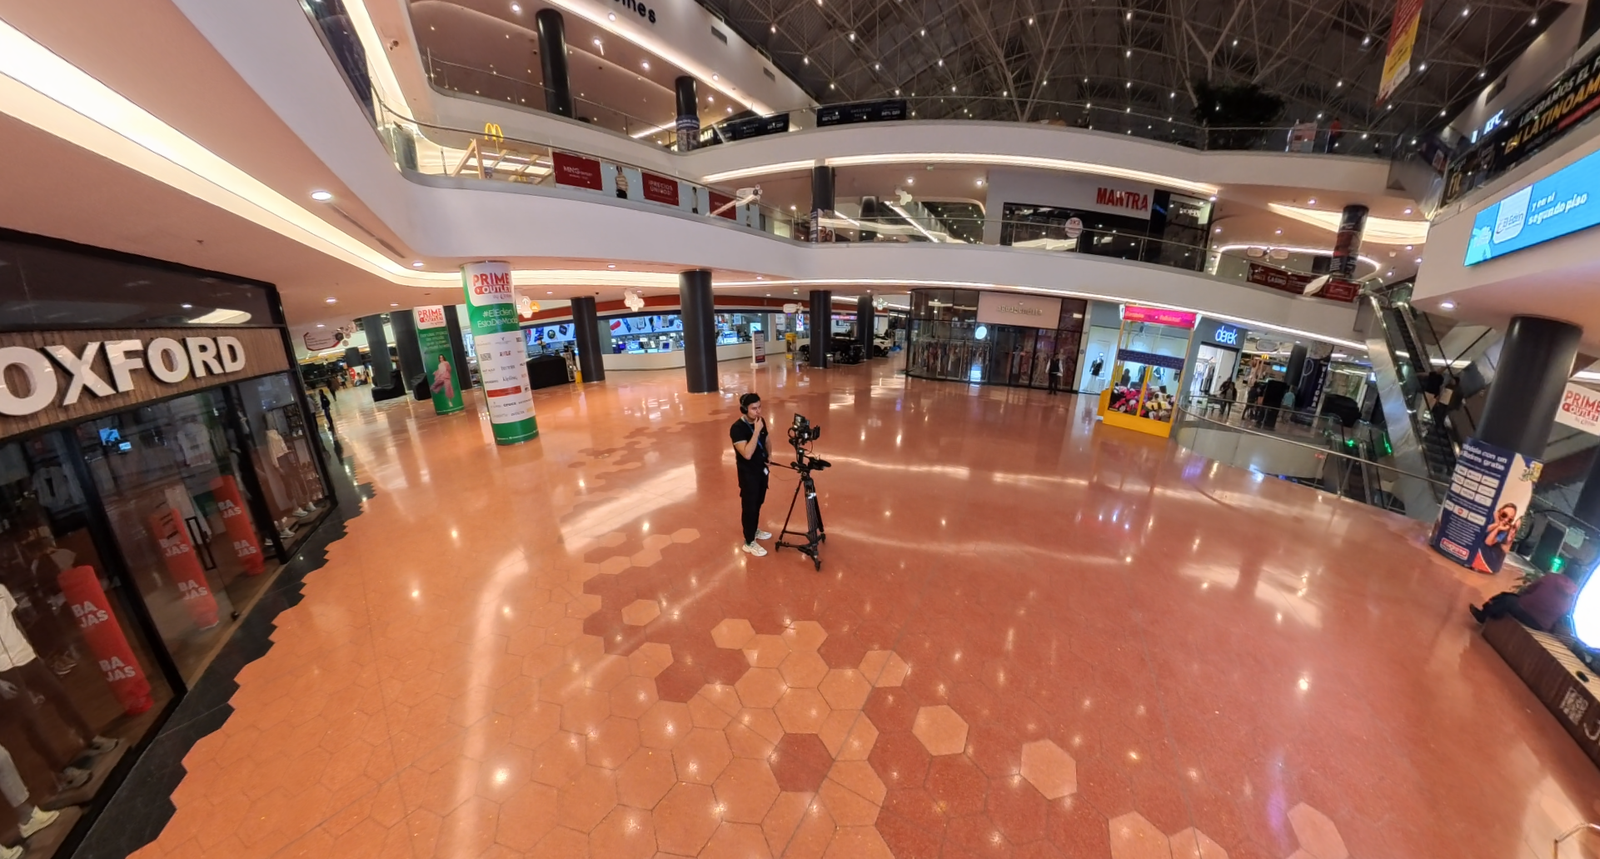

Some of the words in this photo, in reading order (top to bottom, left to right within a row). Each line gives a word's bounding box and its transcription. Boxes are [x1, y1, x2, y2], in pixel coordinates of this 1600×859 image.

[1483, 109, 1504, 134] KFC
[1096, 187, 1149, 212] MANTRA
[1528, 202, 1565, 225] segundo
[1565, 193, 1588, 213] piso
[472, 271, 511, 287] PRIME
[418, 308, 442, 318] PRIME
[1214, 325, 1238, 345] derek
[0, 336, 246, 417] OXFORD
[217, 500, 234, 511] BA
[222, 506, 242, 519] JAS
[165, 543, 189, 557] JAS
[233, 539, 250, 550] BA
[237, 546, 257, 557] JAS
[178, 579, 199, 592] BA
[184, 587, 208, 600] JAS
[71, 601, 98, 618] BA
[80, 609, 109, 628] JAS
[99, 656, 125, 672] BA
[105, 666, 136, 682] JAS
